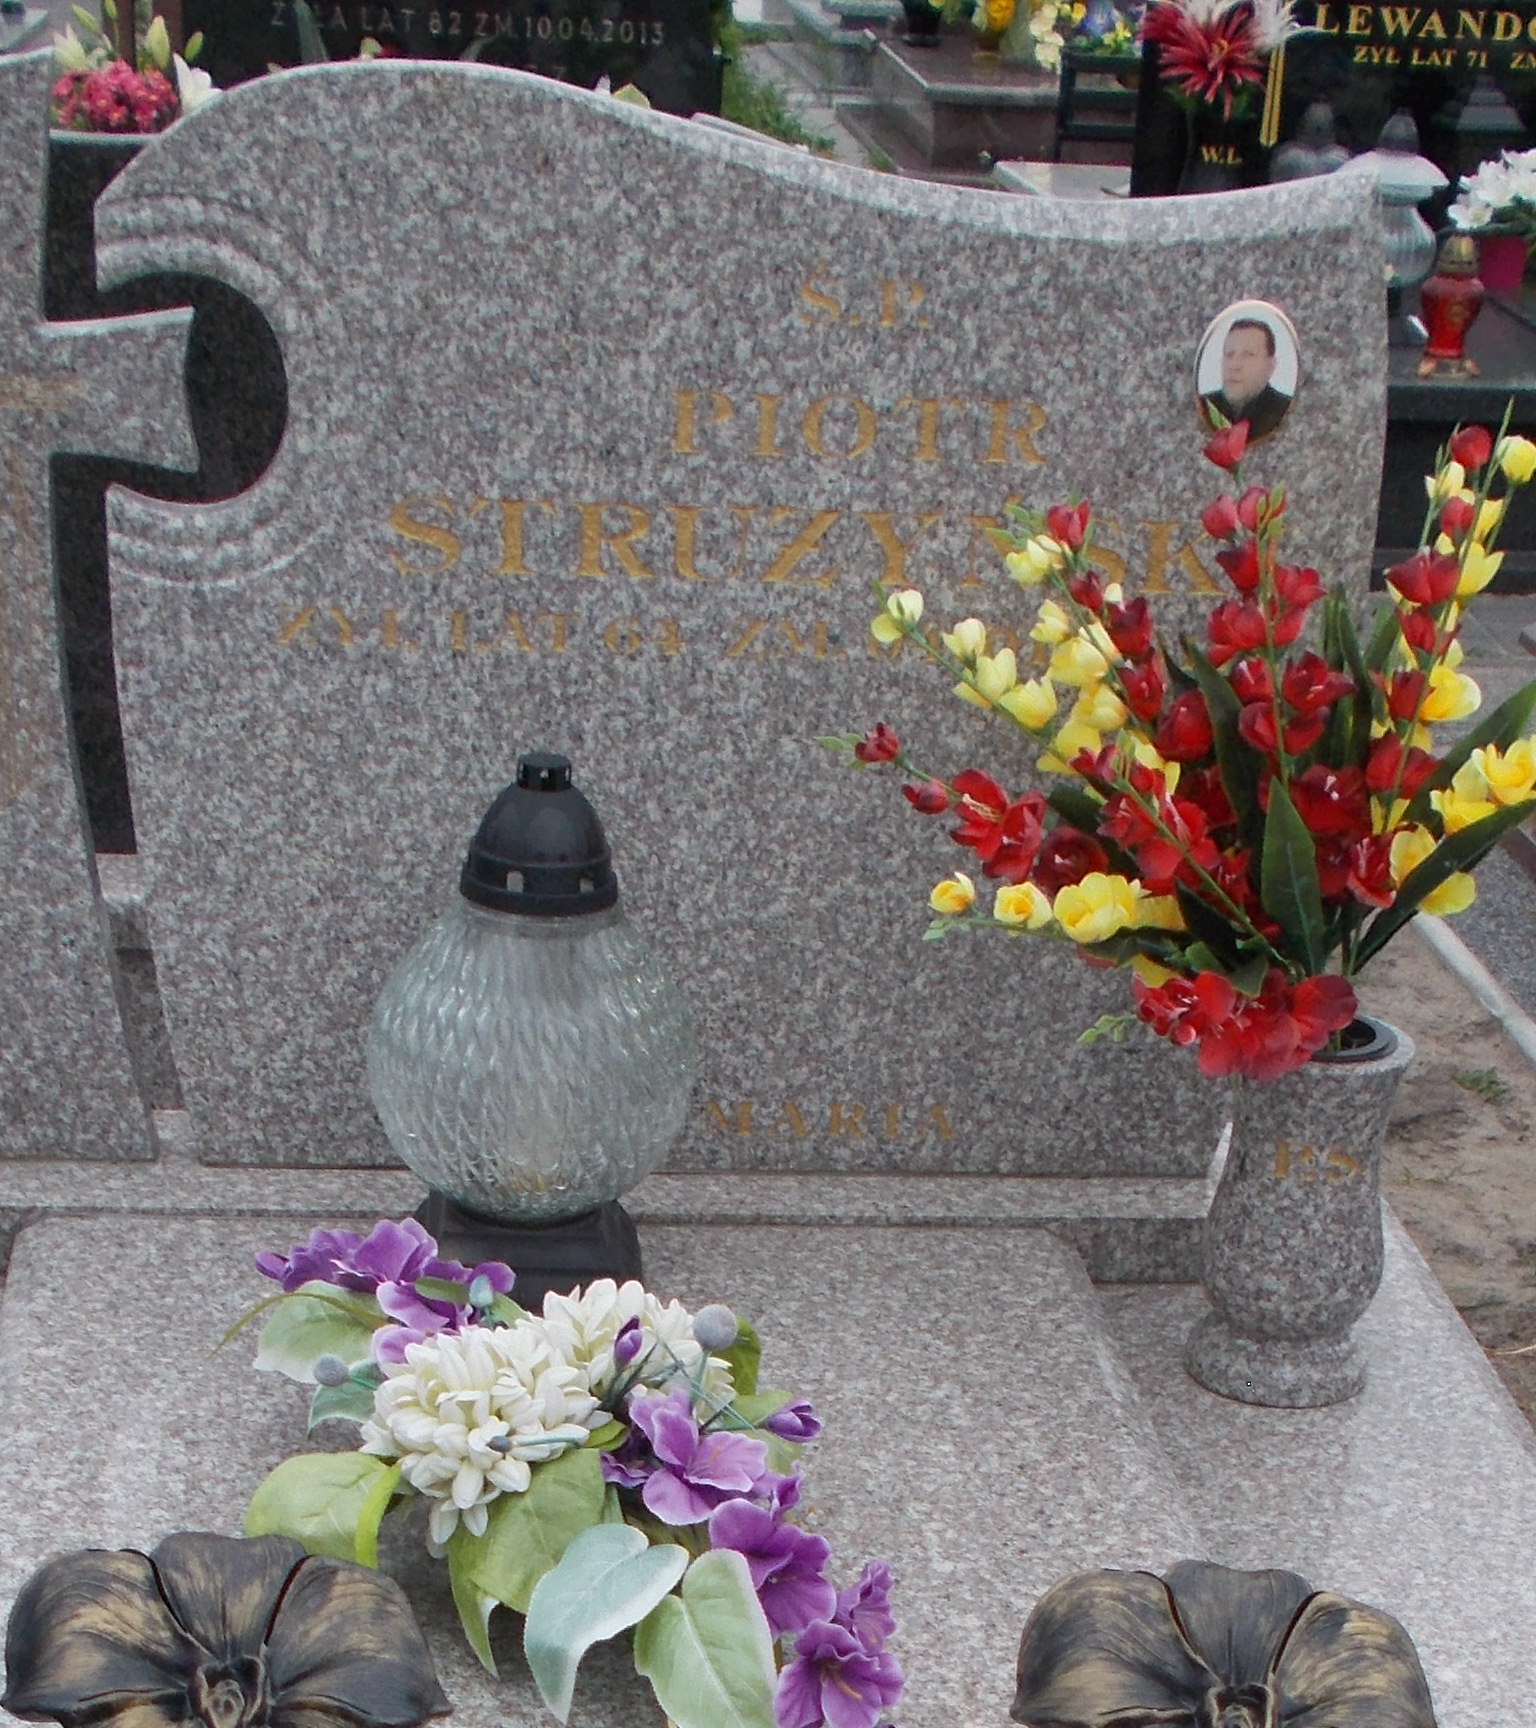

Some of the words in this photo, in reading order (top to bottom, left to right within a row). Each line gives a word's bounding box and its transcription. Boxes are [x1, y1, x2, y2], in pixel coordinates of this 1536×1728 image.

[362, 7, 415, 32] LAT
[429, 11, 462, 35] 82
[1411, 48, 1458, 66] LAT
[1467, 49, 1489, 68] 71
[670, 390, 1048, 464] PIOTR
[451, 610, 581, 652] LAT
[603, 615, 687, 656] 64
[705, 1100, 955, 1139] MARIA
